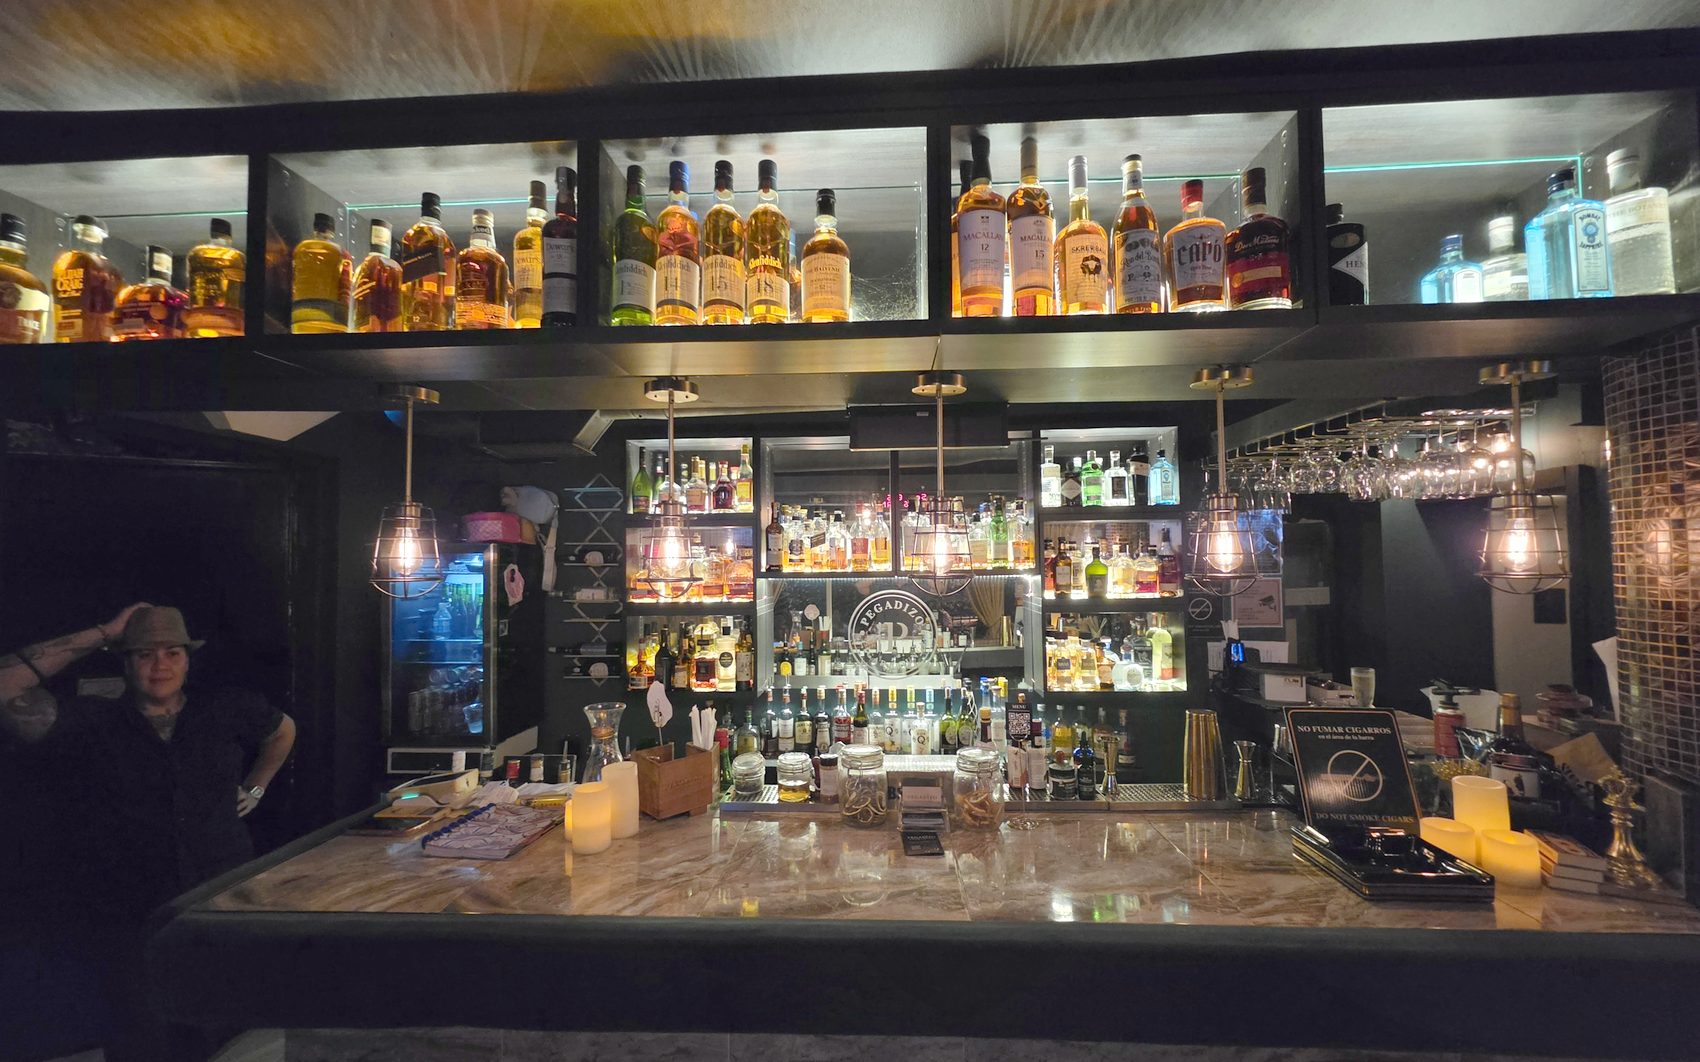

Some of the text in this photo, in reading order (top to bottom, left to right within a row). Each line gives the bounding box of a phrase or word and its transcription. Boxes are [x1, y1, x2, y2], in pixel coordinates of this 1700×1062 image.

[980, 243, 990, 251] 12
[1034, 249, 1045, 259] 15
[710, 275, 727, 291] 15
[757, 277, 774, 293] 18
[860, 600, 924, 627] PEGADIZO
[1297, 725, 1392, 735] NO FUMAR CIGARROS
[1316, 812, 1415, 824] DO NOT SMOKE CIGARS
